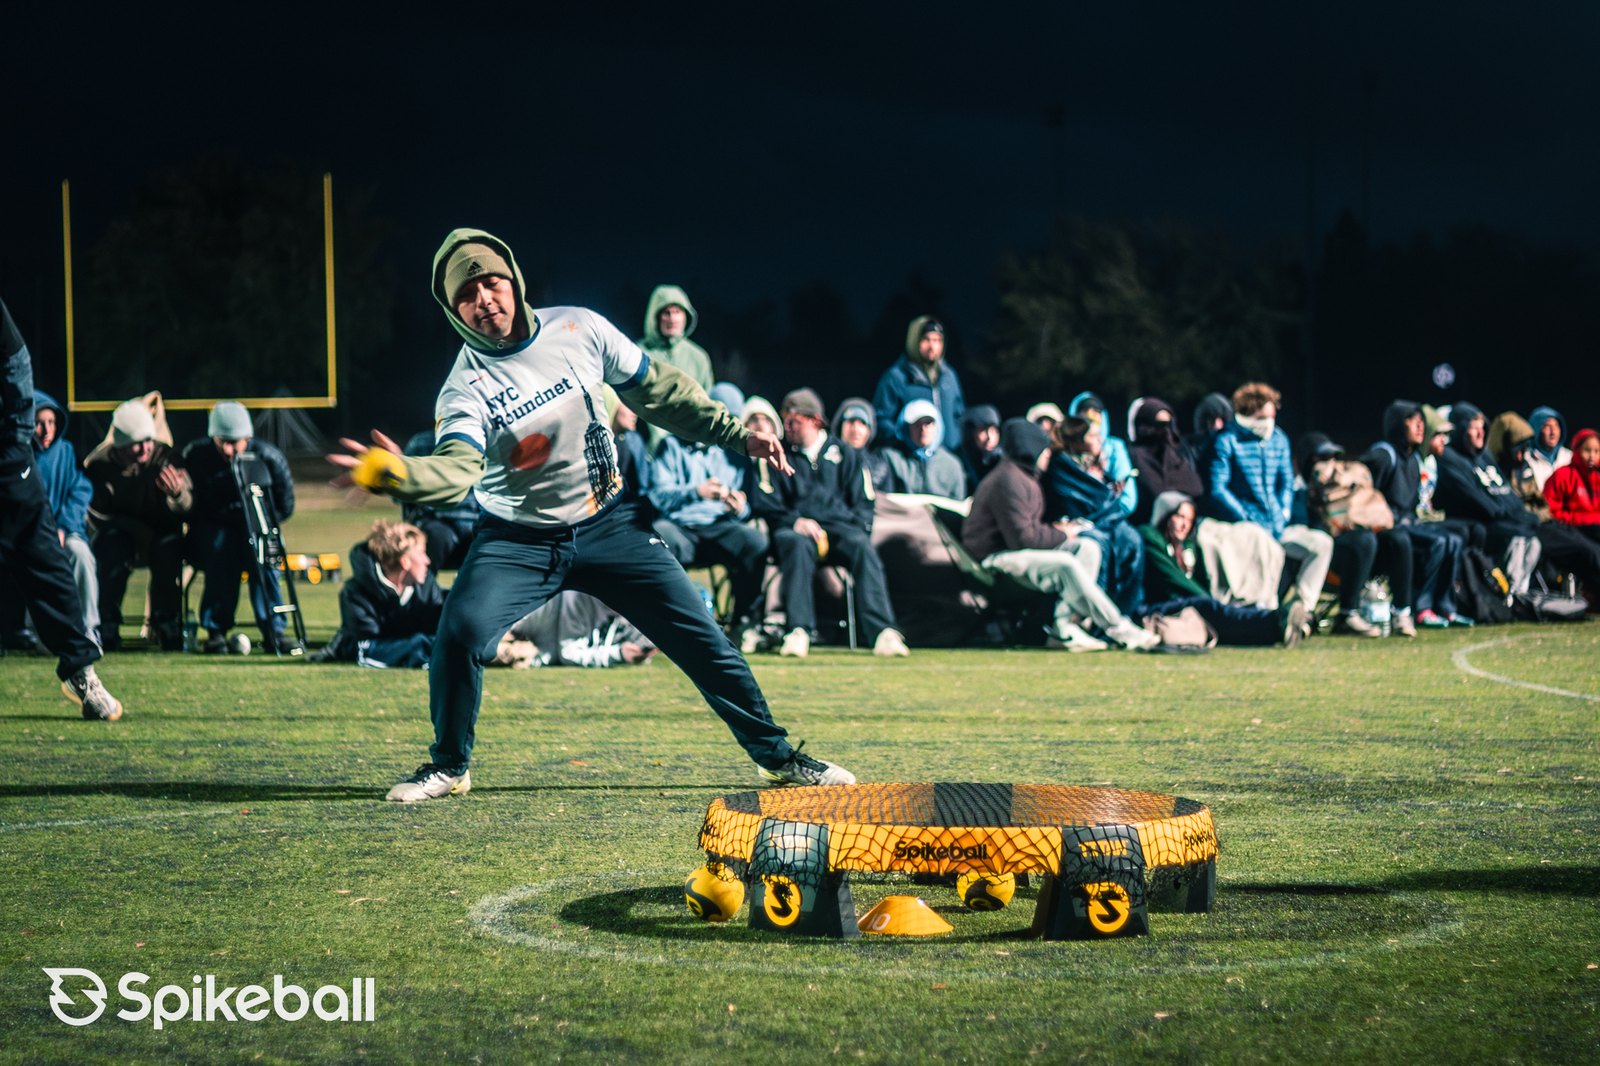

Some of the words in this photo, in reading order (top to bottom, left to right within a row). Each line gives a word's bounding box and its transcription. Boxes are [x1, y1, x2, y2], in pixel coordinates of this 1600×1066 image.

[486, 387, 519, 414] NYC
[491, 377, 573, 430] Roundnet
[893, 840, 988, 859] Spikeball
